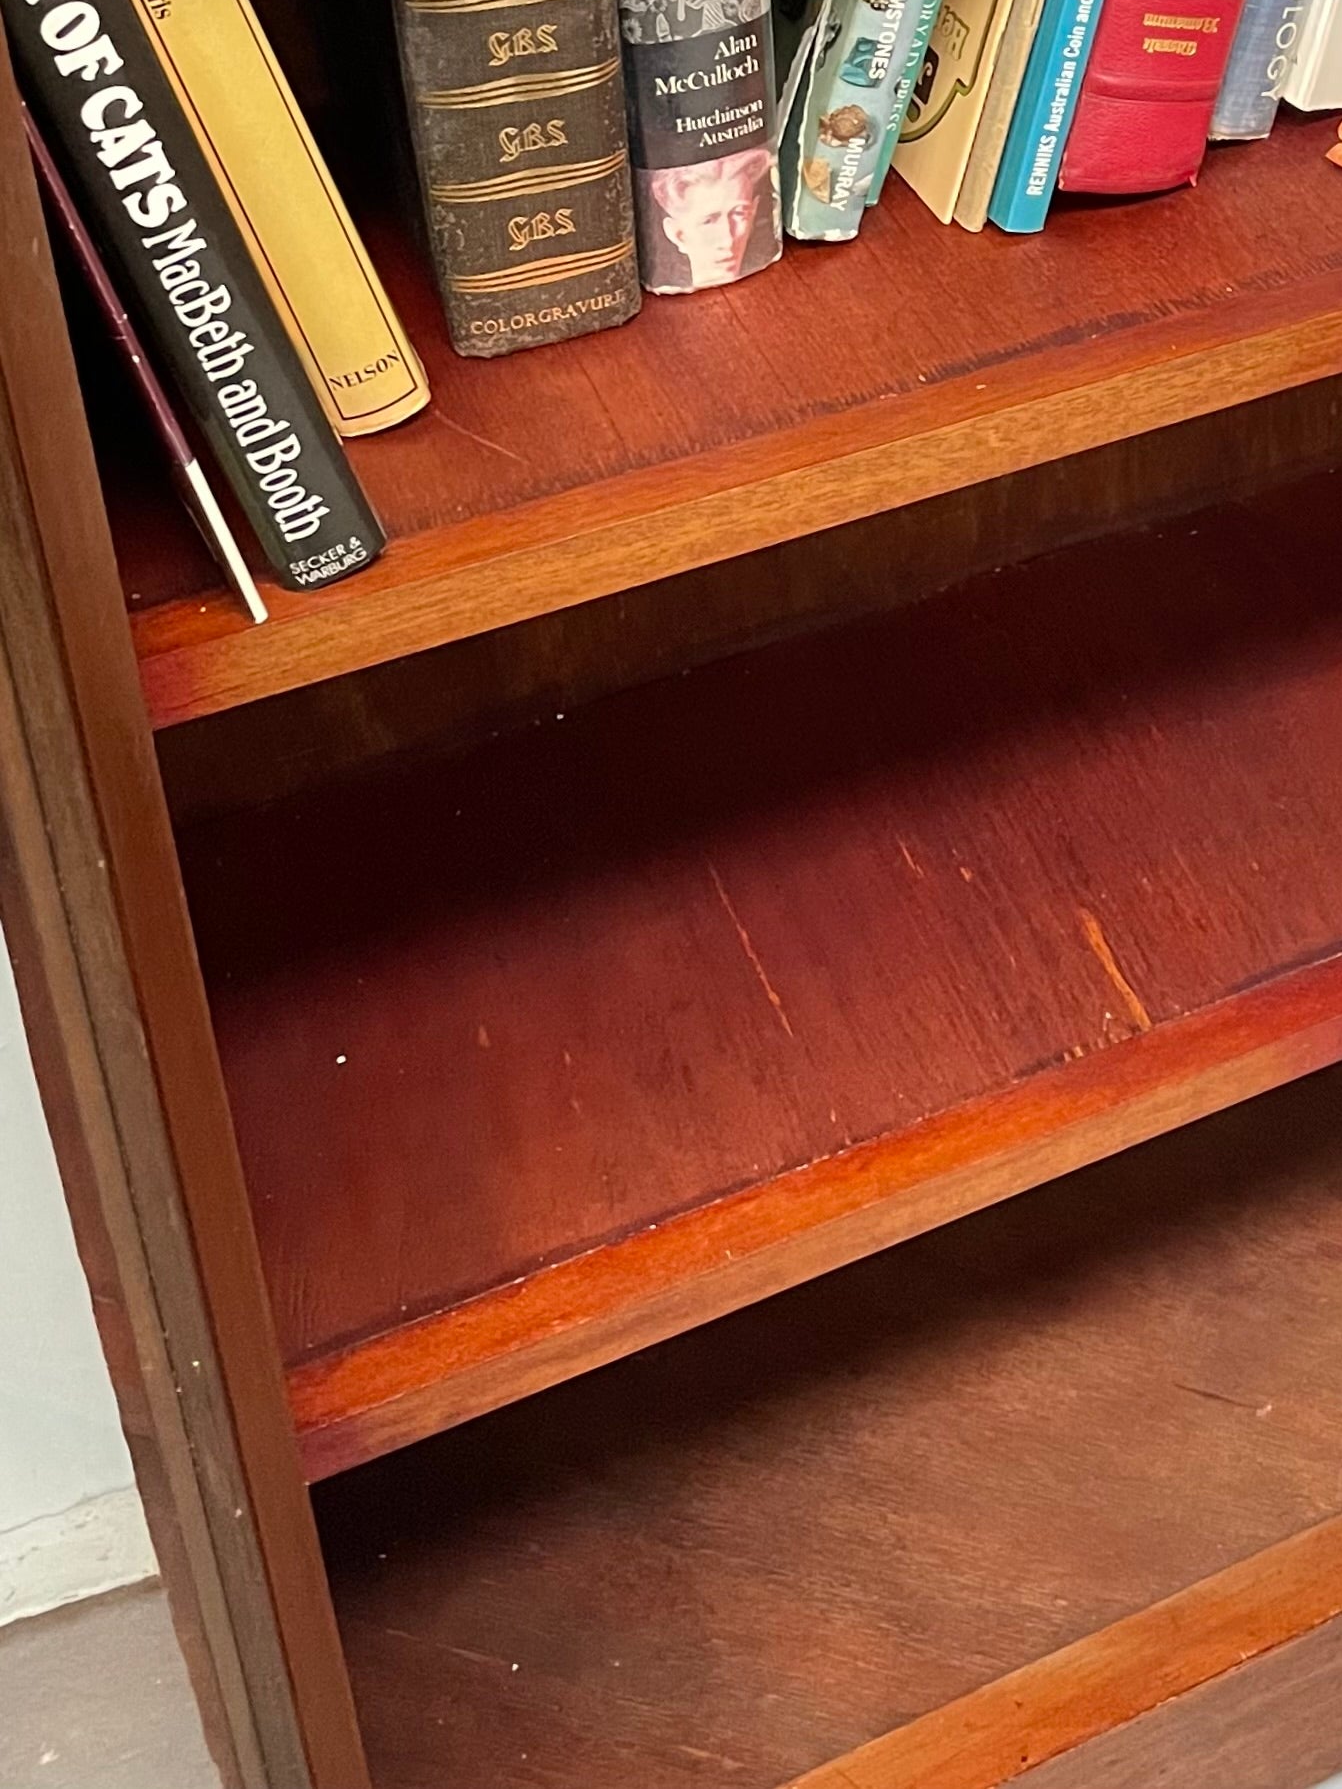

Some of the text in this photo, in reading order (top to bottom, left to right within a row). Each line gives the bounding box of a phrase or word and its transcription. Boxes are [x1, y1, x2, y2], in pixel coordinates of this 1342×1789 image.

[40, 1, 125, 81] OF
[488, 24, 559, 67] GBS
[714, 31, 758, 60] Alan
[654, 56, 760, 97] McCulloch
[676, 96, 764, 134] Hutchinson
[698, 114, 765, 149] Australia
[1026, 134, 1057, 196] RENNIKS
[1043, 61, 1077, 133] Australian
[1063, 25, 1086, 58] Coin
[81, 85, 189, 228] CATS
[499, 118, 568, 163] GBS
[829, 137, 866, 211] MURRAY
[508, 208, 576, 251] GBS
[141, 218, 255, 382] MacBeth
[328, 348, 402, 392] NELSON
[217, 379, 289, 448] and
[247, 434, 331, 544] Booth
[288, 536, 362, 576] SECKER &
[294, 548, 368, 586] WARBURG
